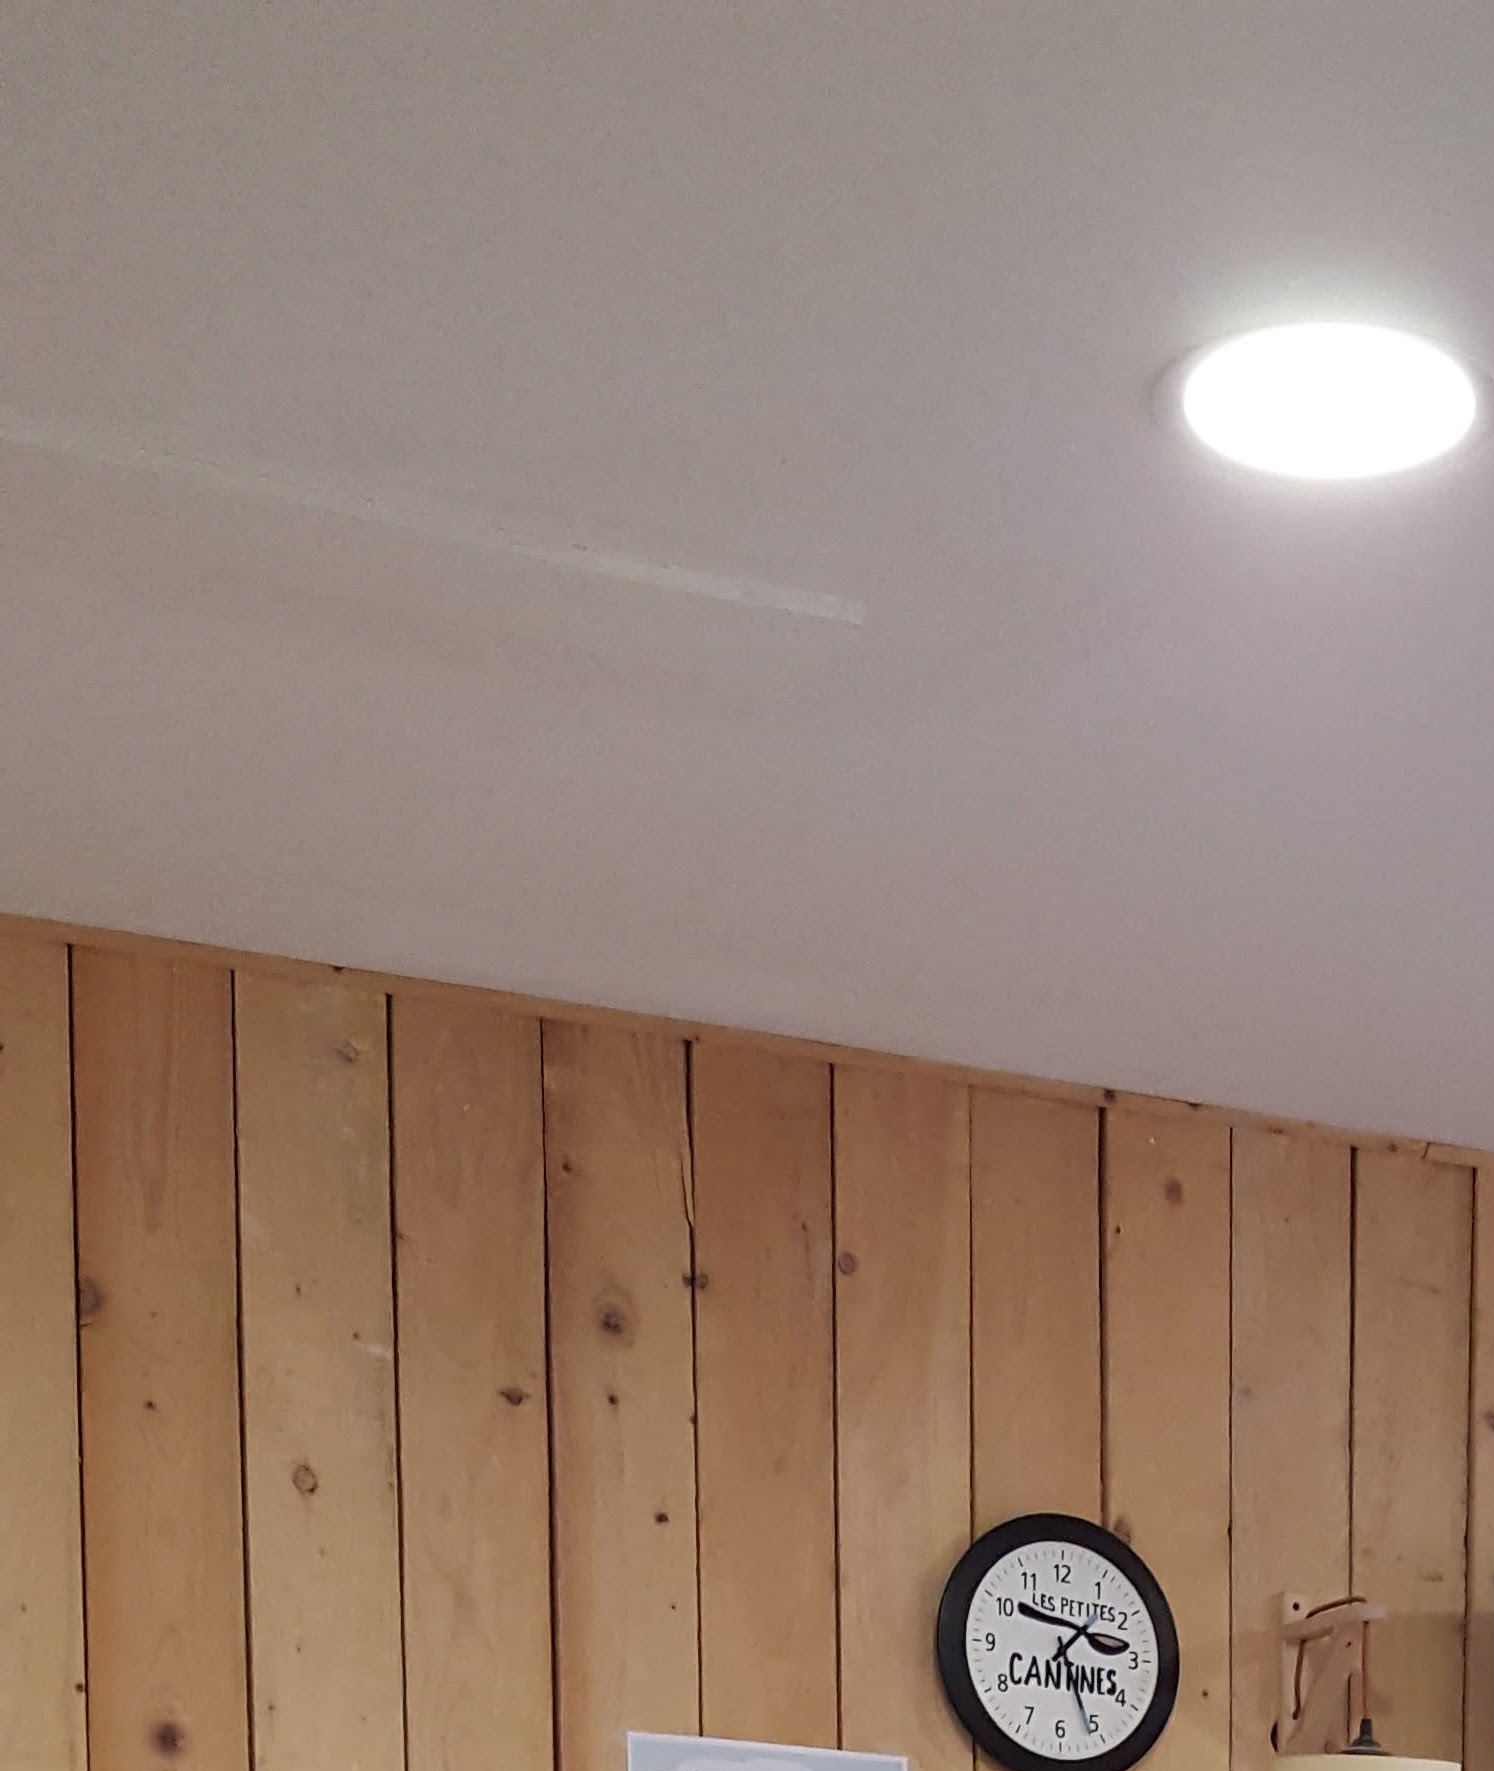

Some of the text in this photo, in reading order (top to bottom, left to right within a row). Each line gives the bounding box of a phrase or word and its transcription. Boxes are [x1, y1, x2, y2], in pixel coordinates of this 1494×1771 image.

[1021, 1572, 1037, 1591] 11
[1053, 1564, 1071, 1584] 12
[1095, 1582, 1101, 1600] 1
[996, 1598, 1014, 1617] 10
[1032, 1592, 1115, 1622] LES PETITES
[1117, 1611, 1128, 1630] 2
[985, 1633, 995, 1651] 9
[1128, 1651, 1139, 1670] 3
[997, 1674, 1008, 1692] 8
[1115, 1689, 1126, 1707] 4
[1024, 1706, 1035, 1725] 7
[1089, 1715, 1099, 1733] 5
[1055, 1720, 1066, 1739] 6
